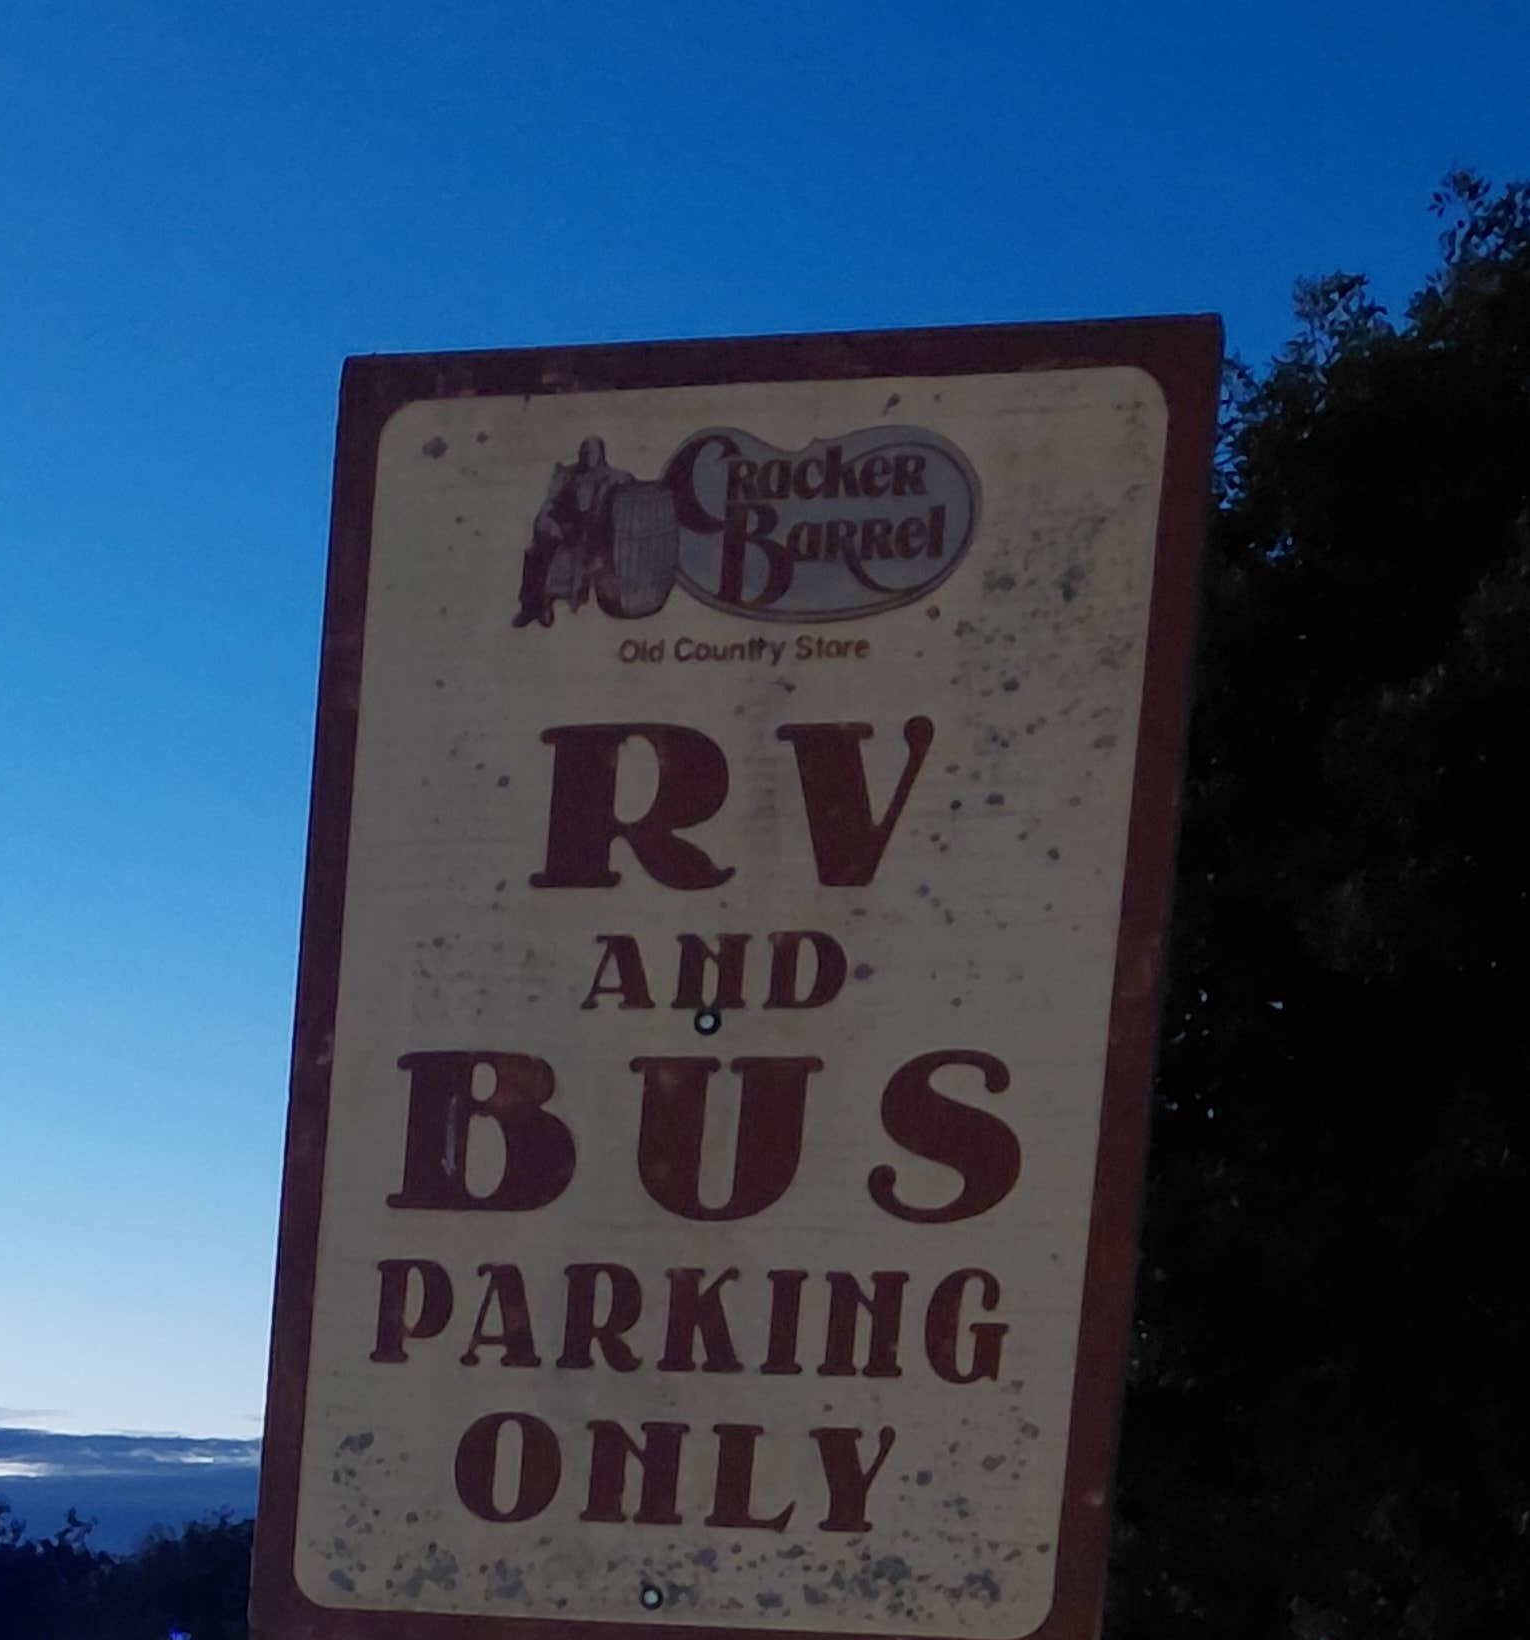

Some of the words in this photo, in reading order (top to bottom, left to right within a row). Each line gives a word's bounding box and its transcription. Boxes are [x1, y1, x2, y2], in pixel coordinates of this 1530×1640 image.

[663, 434, 928, 534] Cracker
[717, 501, 948, 608] Barrel
[618, 638, 665, 664] Old
[674, 637, 783, 665] Country
[795, 635, 871, 661] Store
[528, 715, 935, 891] RV
[580, 930, 848, 1010] AND
[385, 1049, 1022, 1224] BUS
[369, 1258, 1010, 1384] PARKING
[454, 1411, 897, 1533] ONLY
